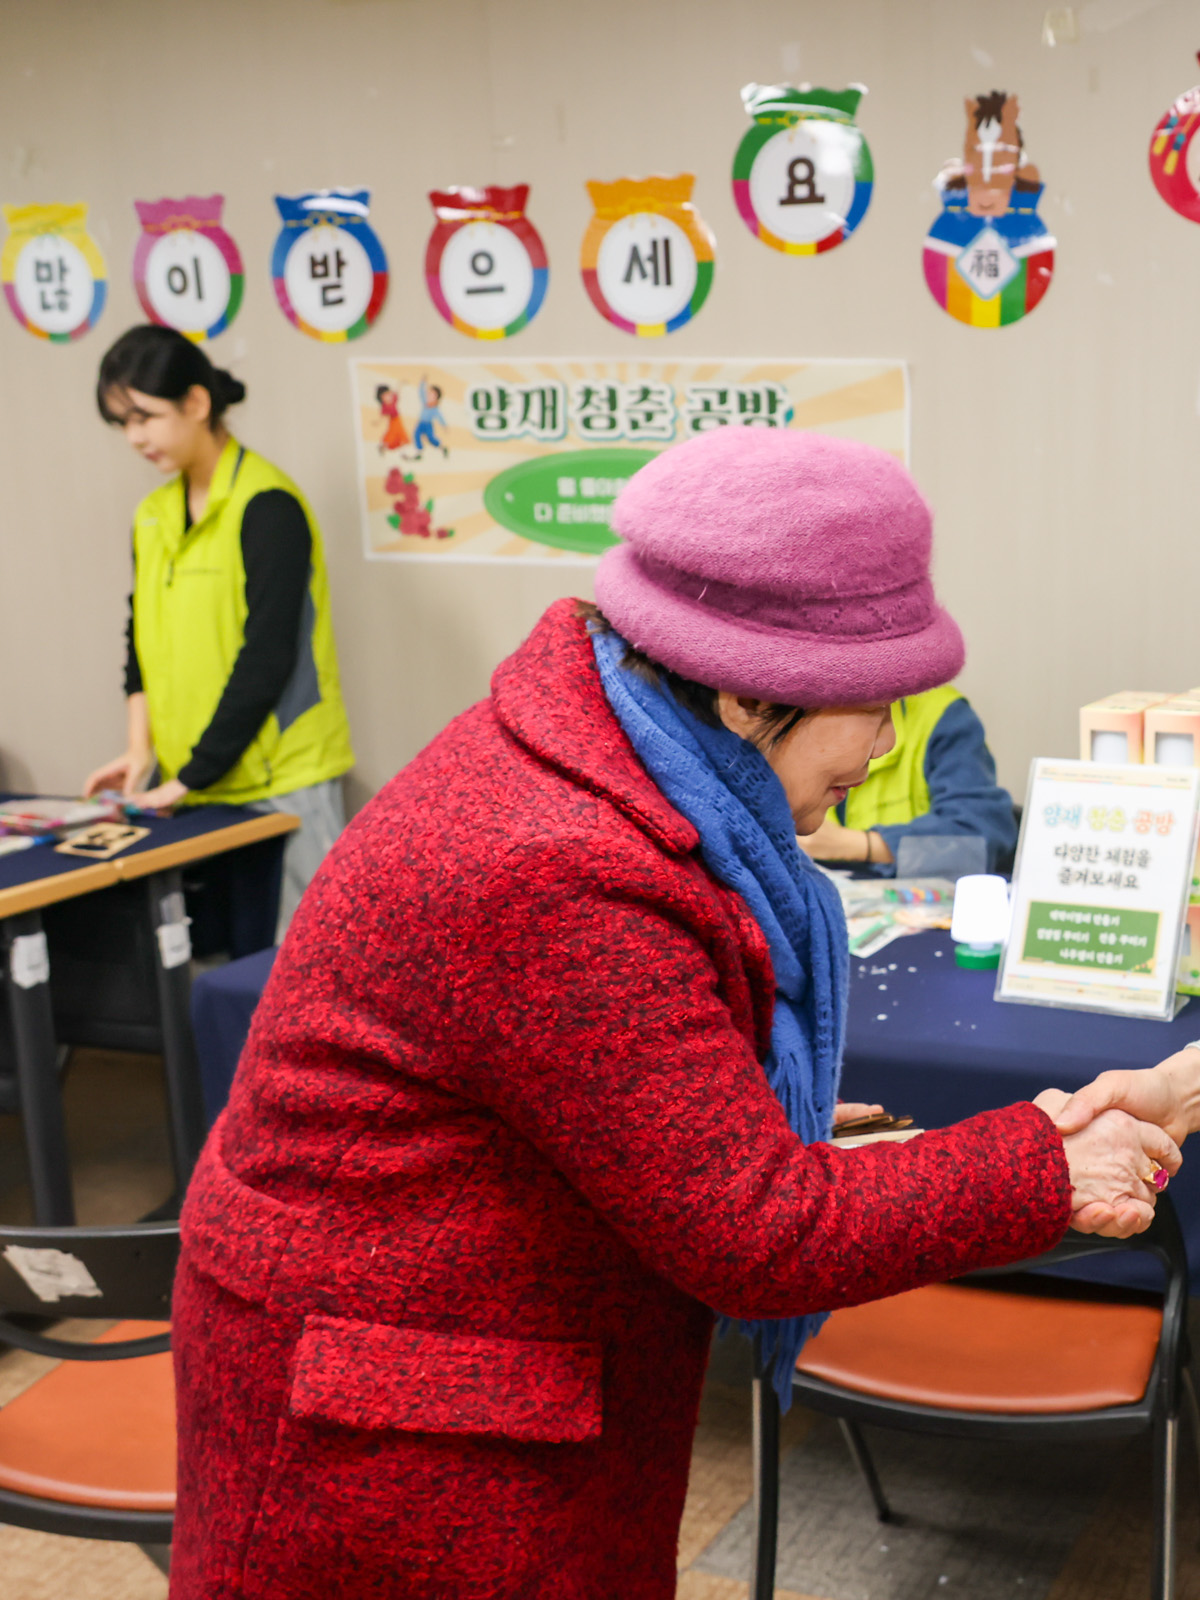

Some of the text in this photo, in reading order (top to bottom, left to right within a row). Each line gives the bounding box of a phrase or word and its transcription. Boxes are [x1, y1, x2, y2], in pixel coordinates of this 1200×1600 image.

[778, 156, 826, 206] 요
[34, 256, 70, 312] 많
[167, 256, 203, 301] 이
[309, 249, 347, 307] 받
[465, 250, 505, 295] 으
[622, 236, 673, 287] 세
[968, 249, 1000, 278] 福
[470, 384, 783, 432] 양재 청춘 공방
[1043, 804, 1082, 829] 양재
[1133, 809, 1175, 836] 공방
[1054, 844, 1151, 869] 다양한 체험을
[1059, 867, 1139, 890] 즐겨보세요
